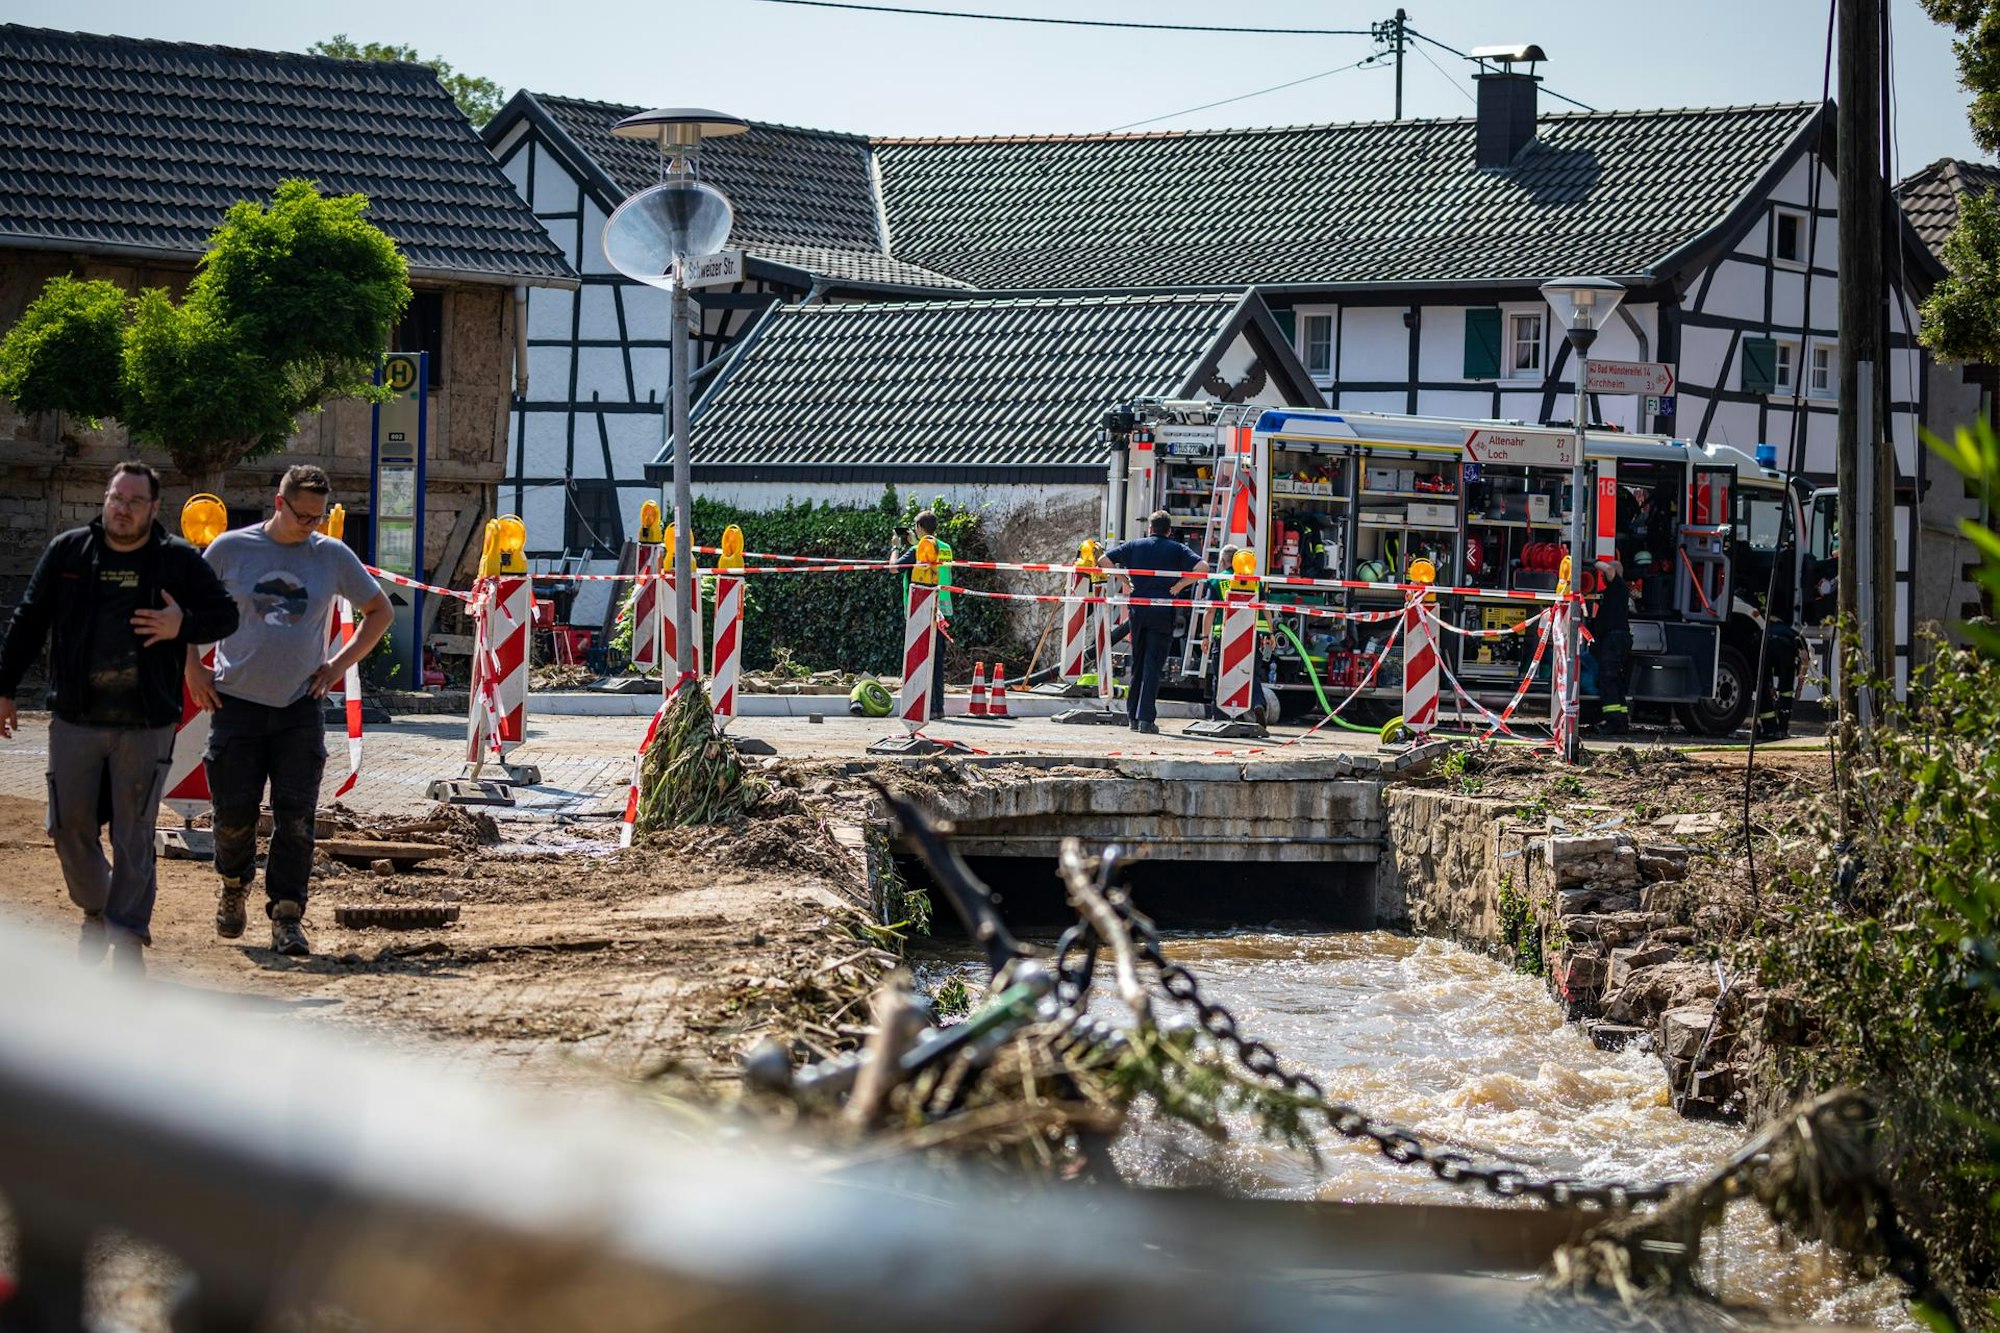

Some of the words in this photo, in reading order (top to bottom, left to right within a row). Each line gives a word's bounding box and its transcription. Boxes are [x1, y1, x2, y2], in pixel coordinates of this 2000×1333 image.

[688, 259, 722, 280] Schweizer
[724, 257, 736, 275] Str.
[392, 364, 406, 382] H
[1598, 364, 1607, 374] Bad
[1609, 365, 1642, 376] Münstereifel
[1644, 367, 1650, 376] 14
[1589, 378, 1624, 389] Kirchheim
[1648, 399, 1657, 411] F3
[1489, 435, 1525, 447] Altenahr
[1556, 439, 1565, 448] 27
[1488, 449, 1508, 460] Loch
[1600, 480, 1616, 496] 18
